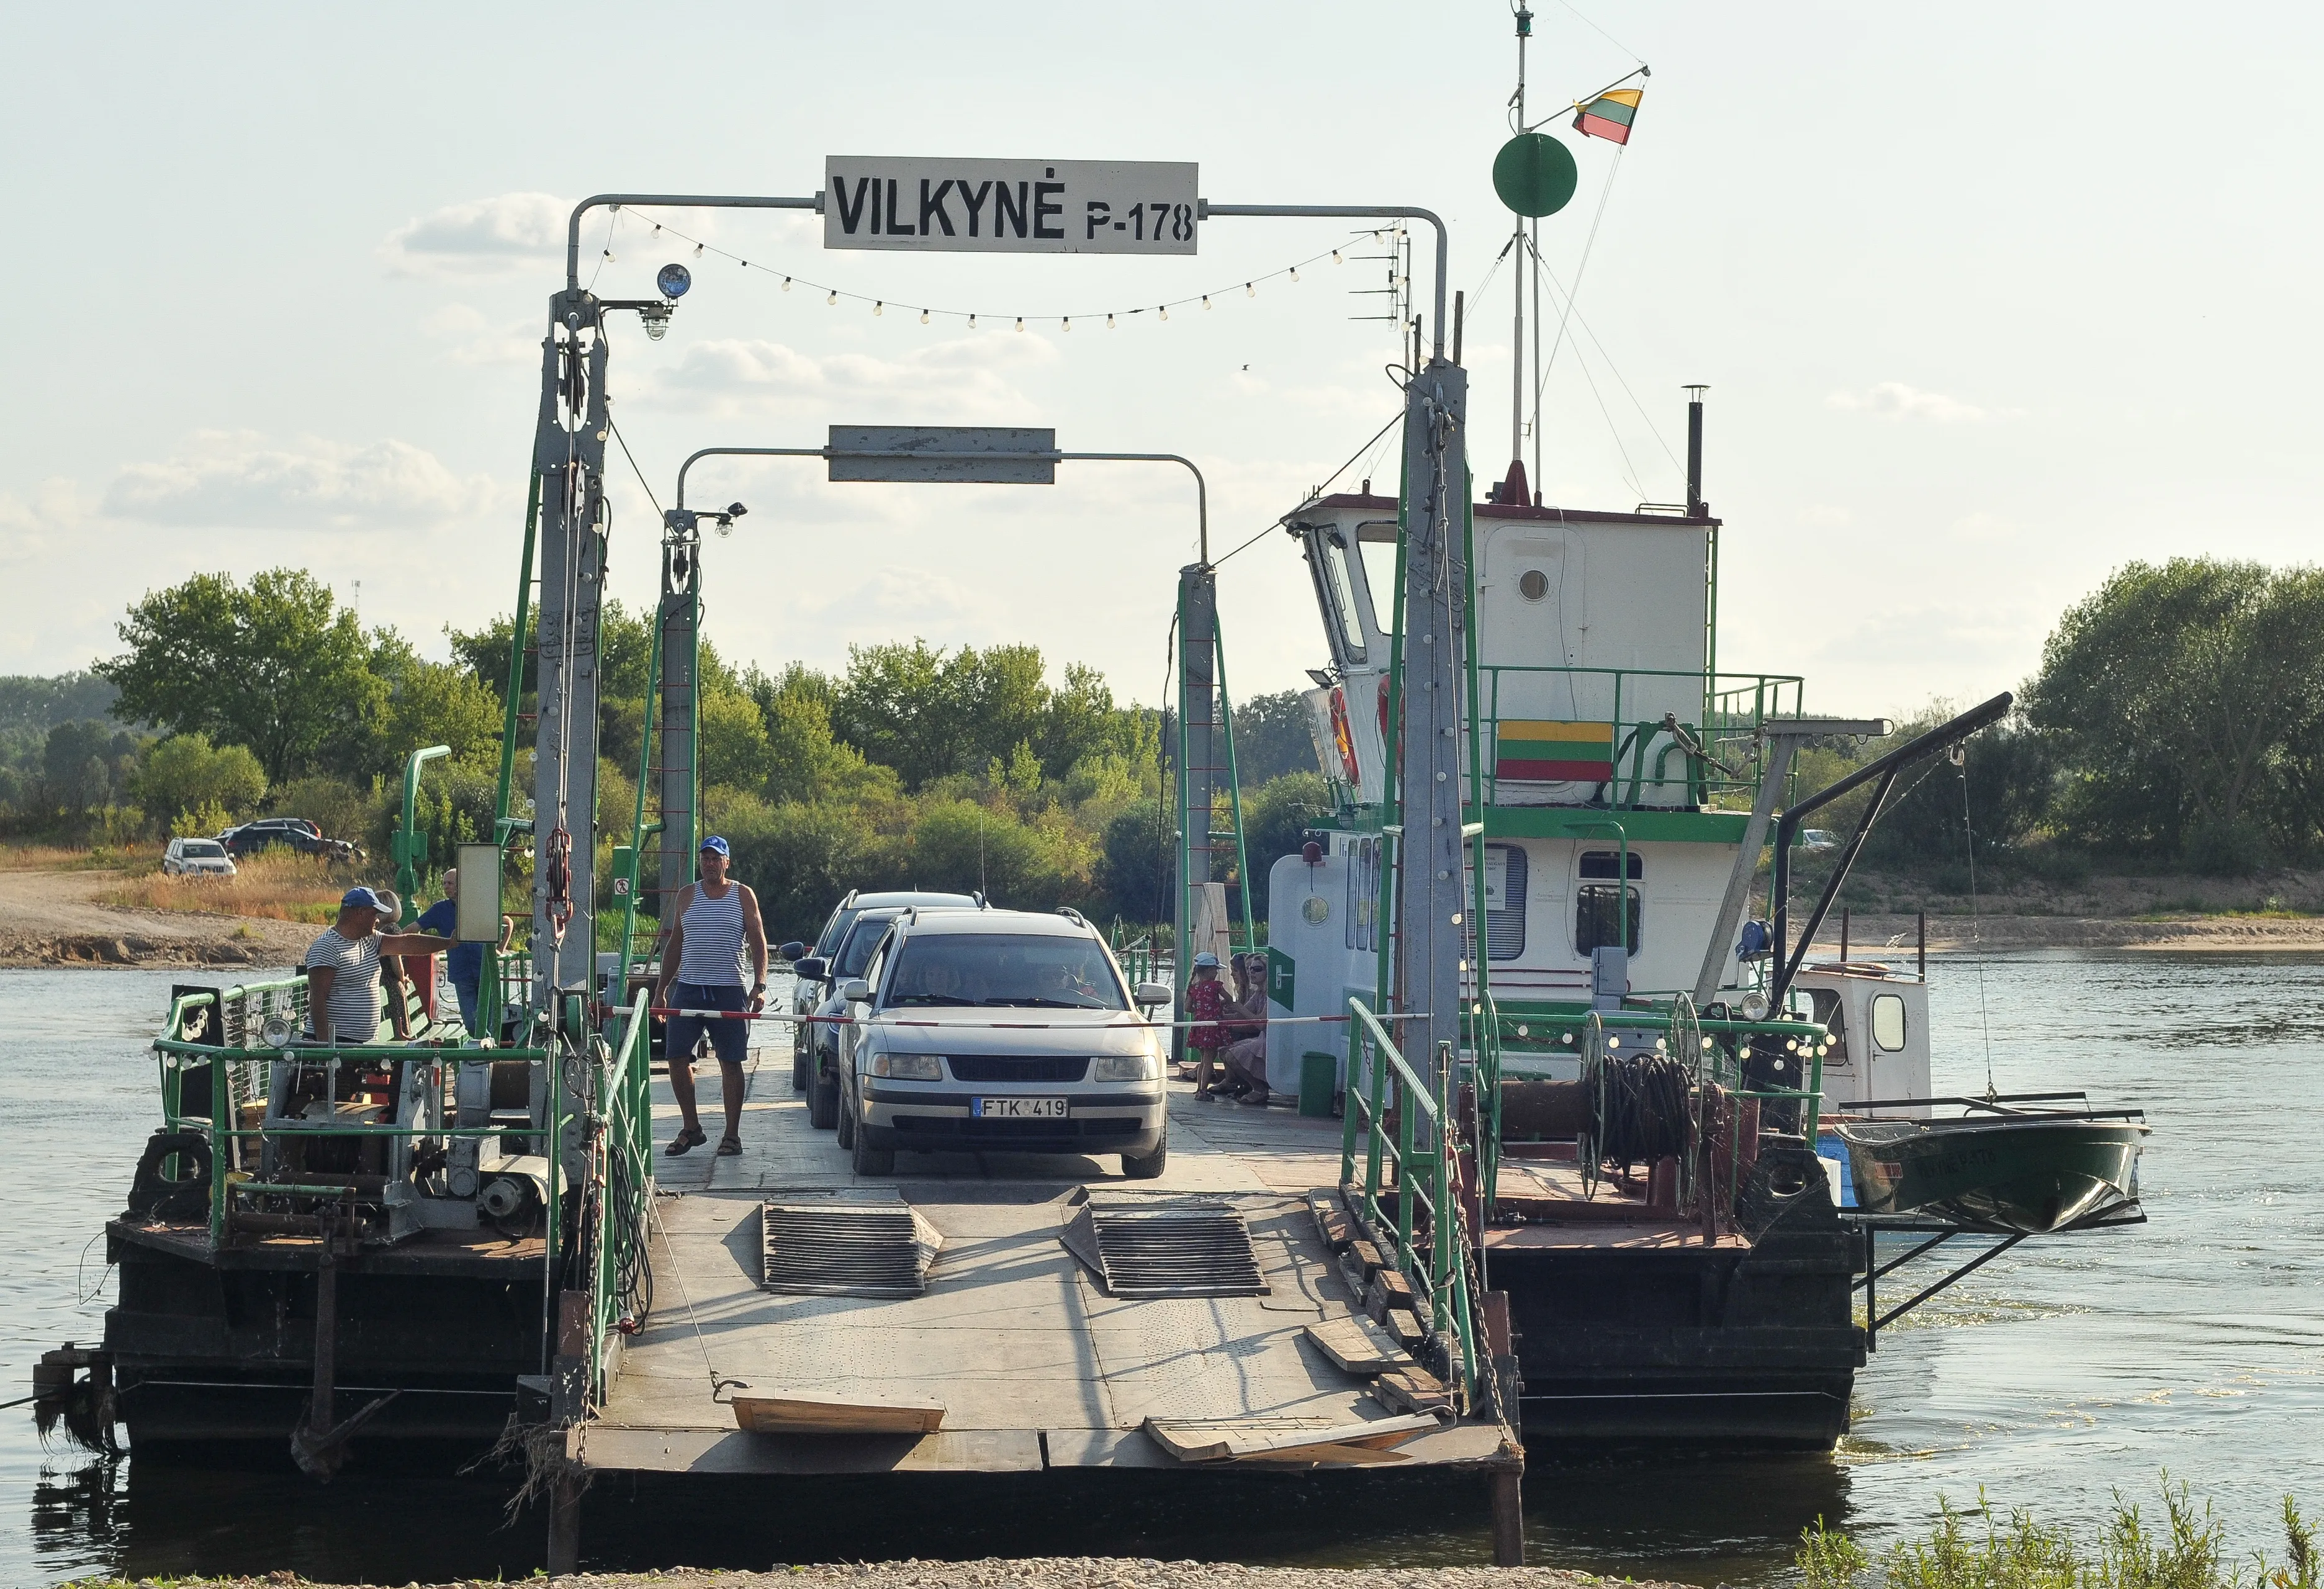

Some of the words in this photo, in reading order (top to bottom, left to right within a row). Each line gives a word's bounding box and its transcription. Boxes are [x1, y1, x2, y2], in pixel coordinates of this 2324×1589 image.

[832, 167, 1066, 240] VILKYNĖ
[1086, 201, 1194, 242] P-178
[983, 1100, 1020, 1116] FTK
[1033, 1100, 1065, 1116] 419
